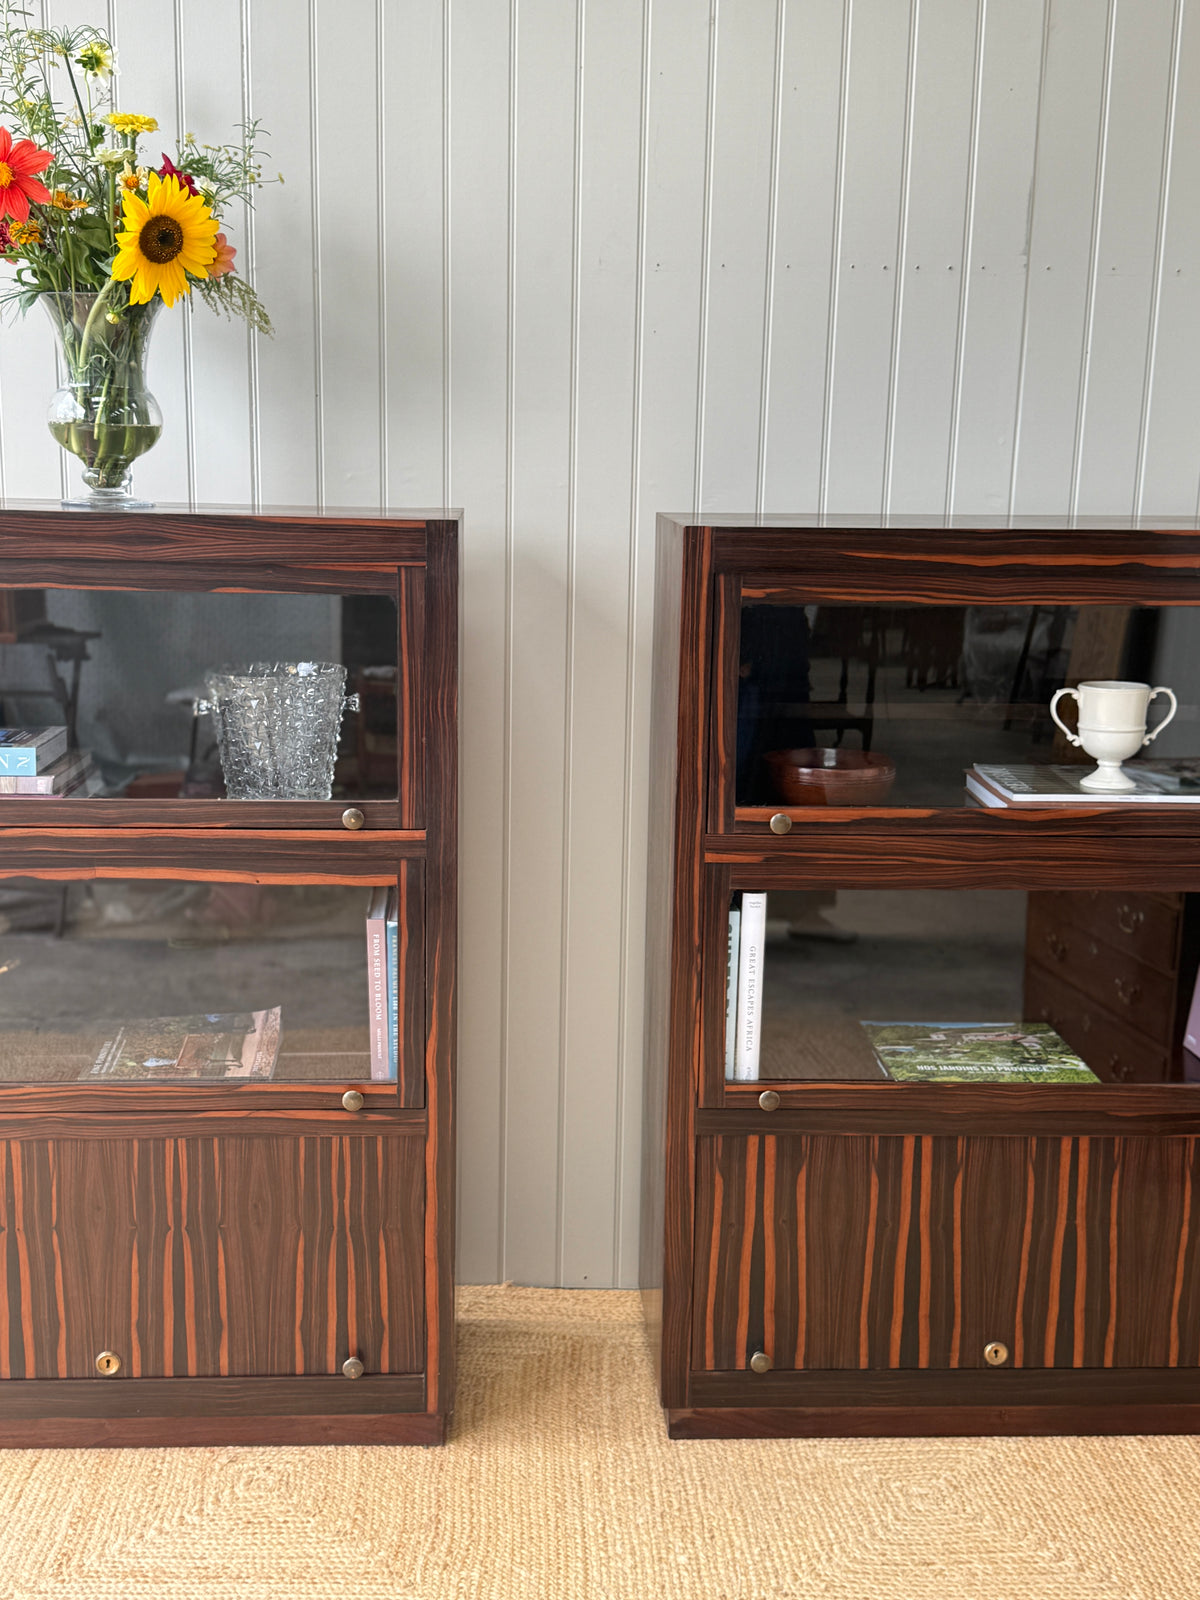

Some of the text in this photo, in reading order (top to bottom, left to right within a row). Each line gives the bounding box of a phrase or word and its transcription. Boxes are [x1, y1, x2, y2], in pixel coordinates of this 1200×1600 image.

[372, 934, 380, 956] FROM
[373, 958, 381, 978] SEED
[374, 980, 381, 991] TO
[745, 946, 757, 1052] GREAT ESCAPES AFRICA
